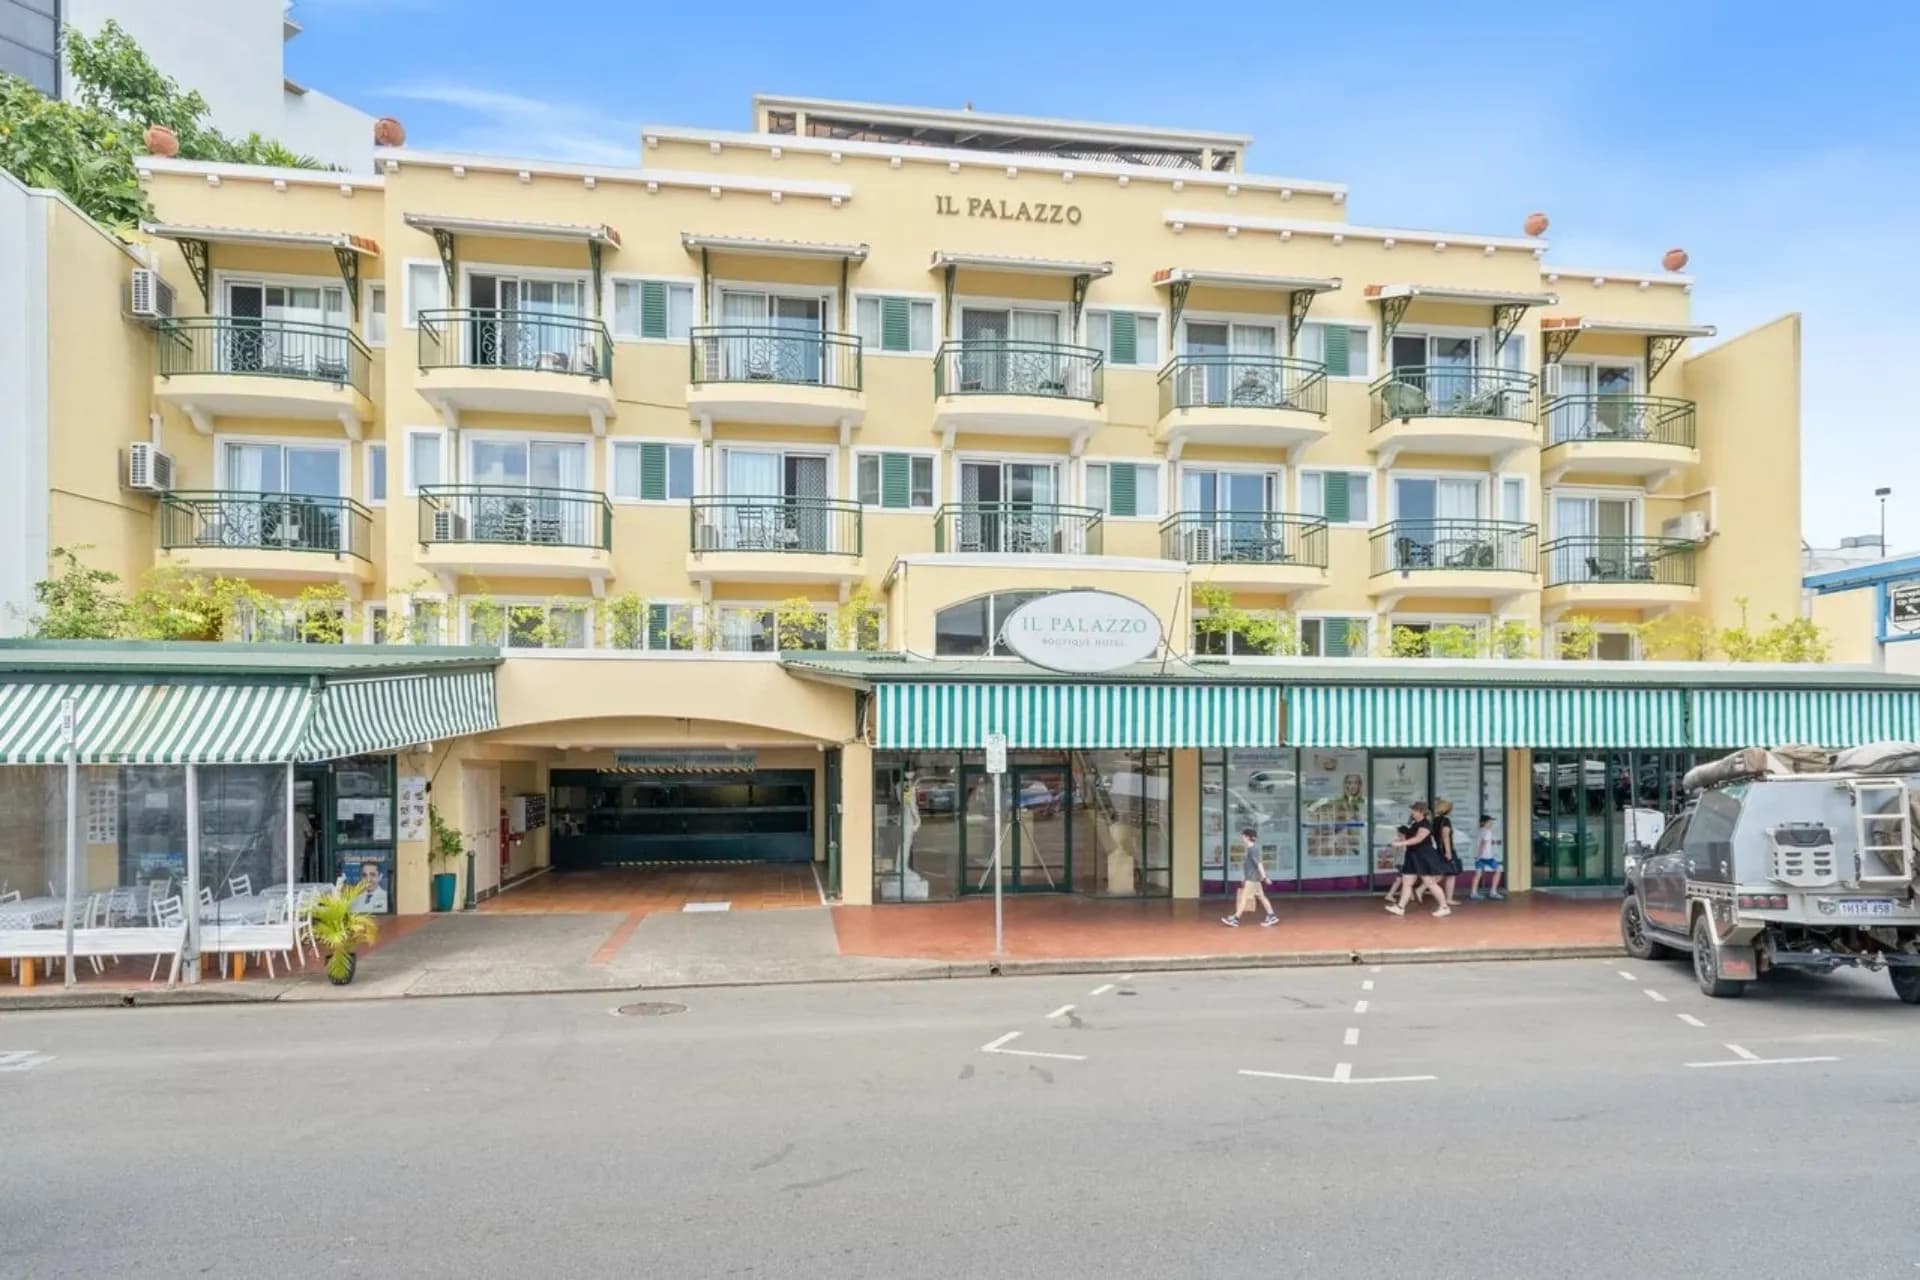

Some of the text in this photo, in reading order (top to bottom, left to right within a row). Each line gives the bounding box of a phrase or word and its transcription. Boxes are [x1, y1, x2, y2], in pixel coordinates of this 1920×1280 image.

[935, 194, 1082, 225] IL PALAZZO
[1022, 616, 1148, 634] IL PALAZZO
[1042, 638, 1125, 648] BOUTIQUE HOTEL
